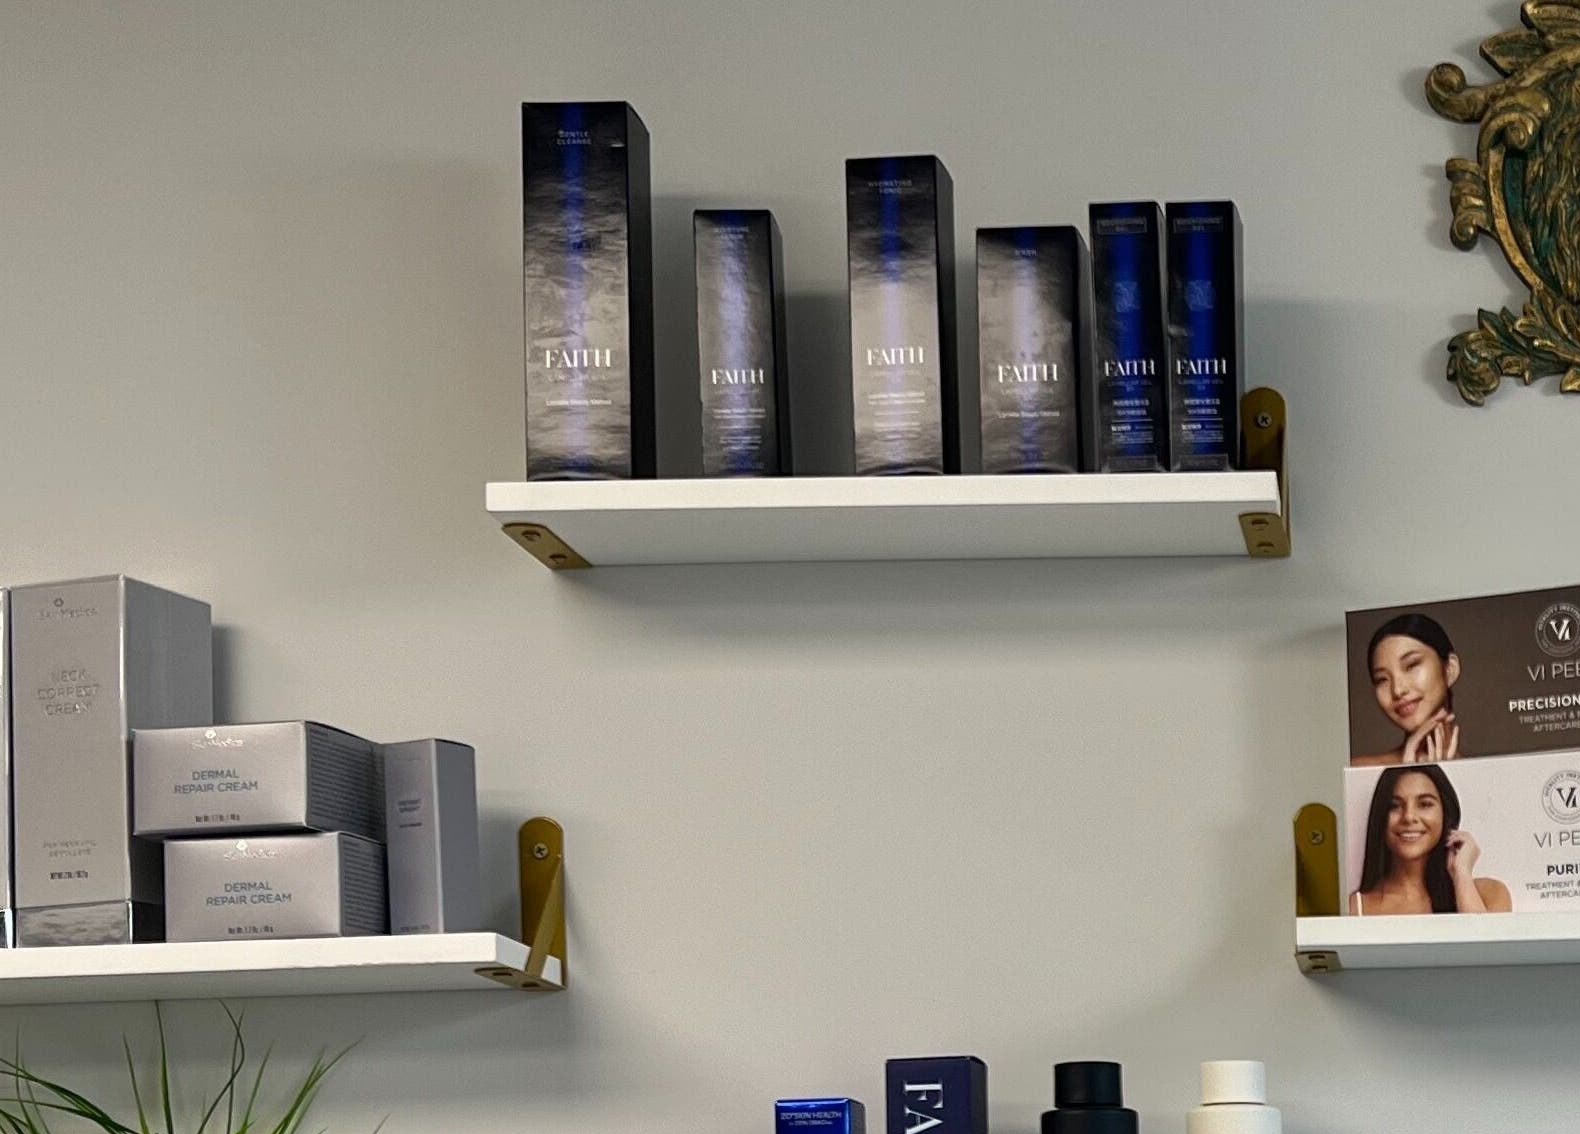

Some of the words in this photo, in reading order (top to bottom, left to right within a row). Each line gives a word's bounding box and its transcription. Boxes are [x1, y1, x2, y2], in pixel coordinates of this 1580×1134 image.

[545, 348, 611, 369] FAITH
[866, 345, 924, 366] FAITH
[997, 362, 1059, 384] FAITH
[1103, 358, 1155, 377] FAITH
[1176, 357, 1227, 375] FAITH
[711, 367, 765, 386] FAITH
[1527, 664, 1545, 682] VI
[1519, 711, 1567, 725] TREATMENT
[1569, 710, 1576, 720] &
[191, 768, 240, 781] DERMAL
[174, 783, 215, 794] REPAIR
[217, 780, 258, 793] CREAM
[1533, 831, 1553, 849] VI
[224, 881, 273, 893] DERMAL
[1525, 880, 1574, 891] TREATMENT
[206, 895, 247, 906] REPAIR
[250, 892, 292, 904] CREAM
